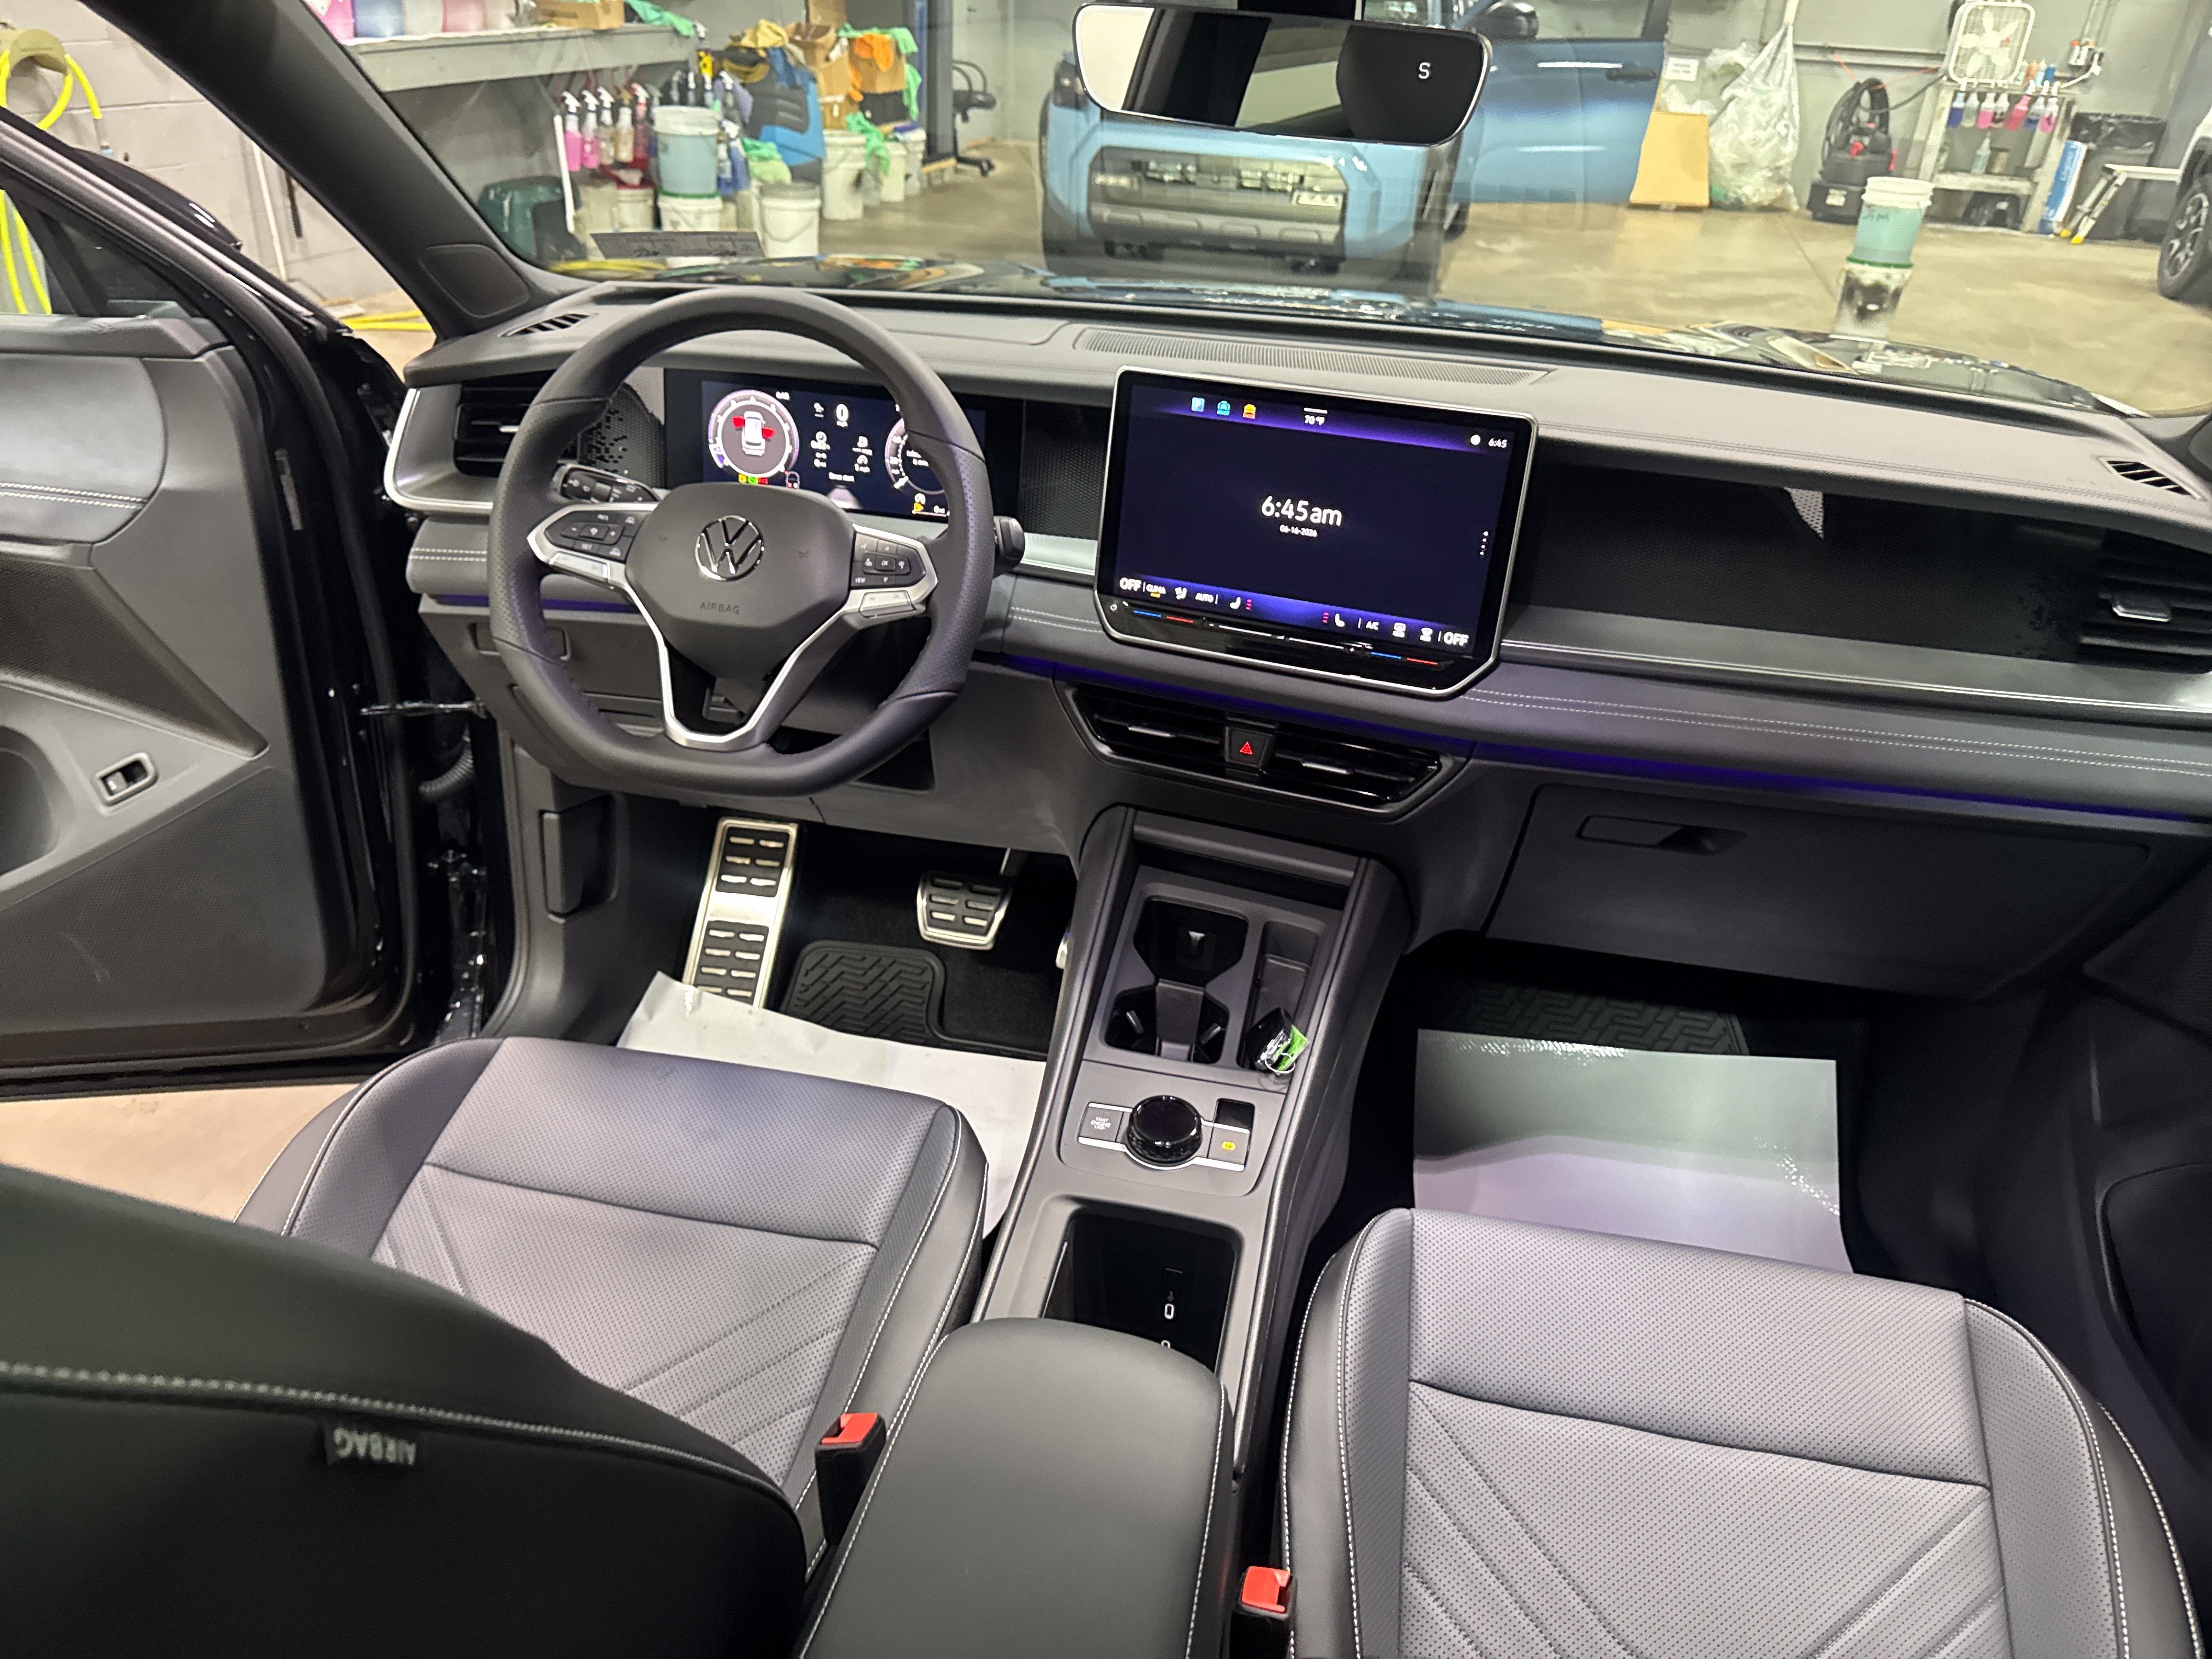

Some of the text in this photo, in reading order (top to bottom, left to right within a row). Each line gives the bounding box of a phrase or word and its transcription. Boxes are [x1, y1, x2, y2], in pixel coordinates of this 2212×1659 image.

[1419, 62, 1430, 79] S
[836, 404, 849, 421] 0
[1488, 438, 1508, 448] 6:45
[1279, 524, 1318, 538] 06-16-2026
[1119, 577, 1142, 591] OFF
[1195, 592, 1214, 603] AUTO
[699, 602, 740, 615] AIRBAG
[1443, 631, 1470, 646] OFF
[1091, 1120, 1111, 1128] ENGINE
